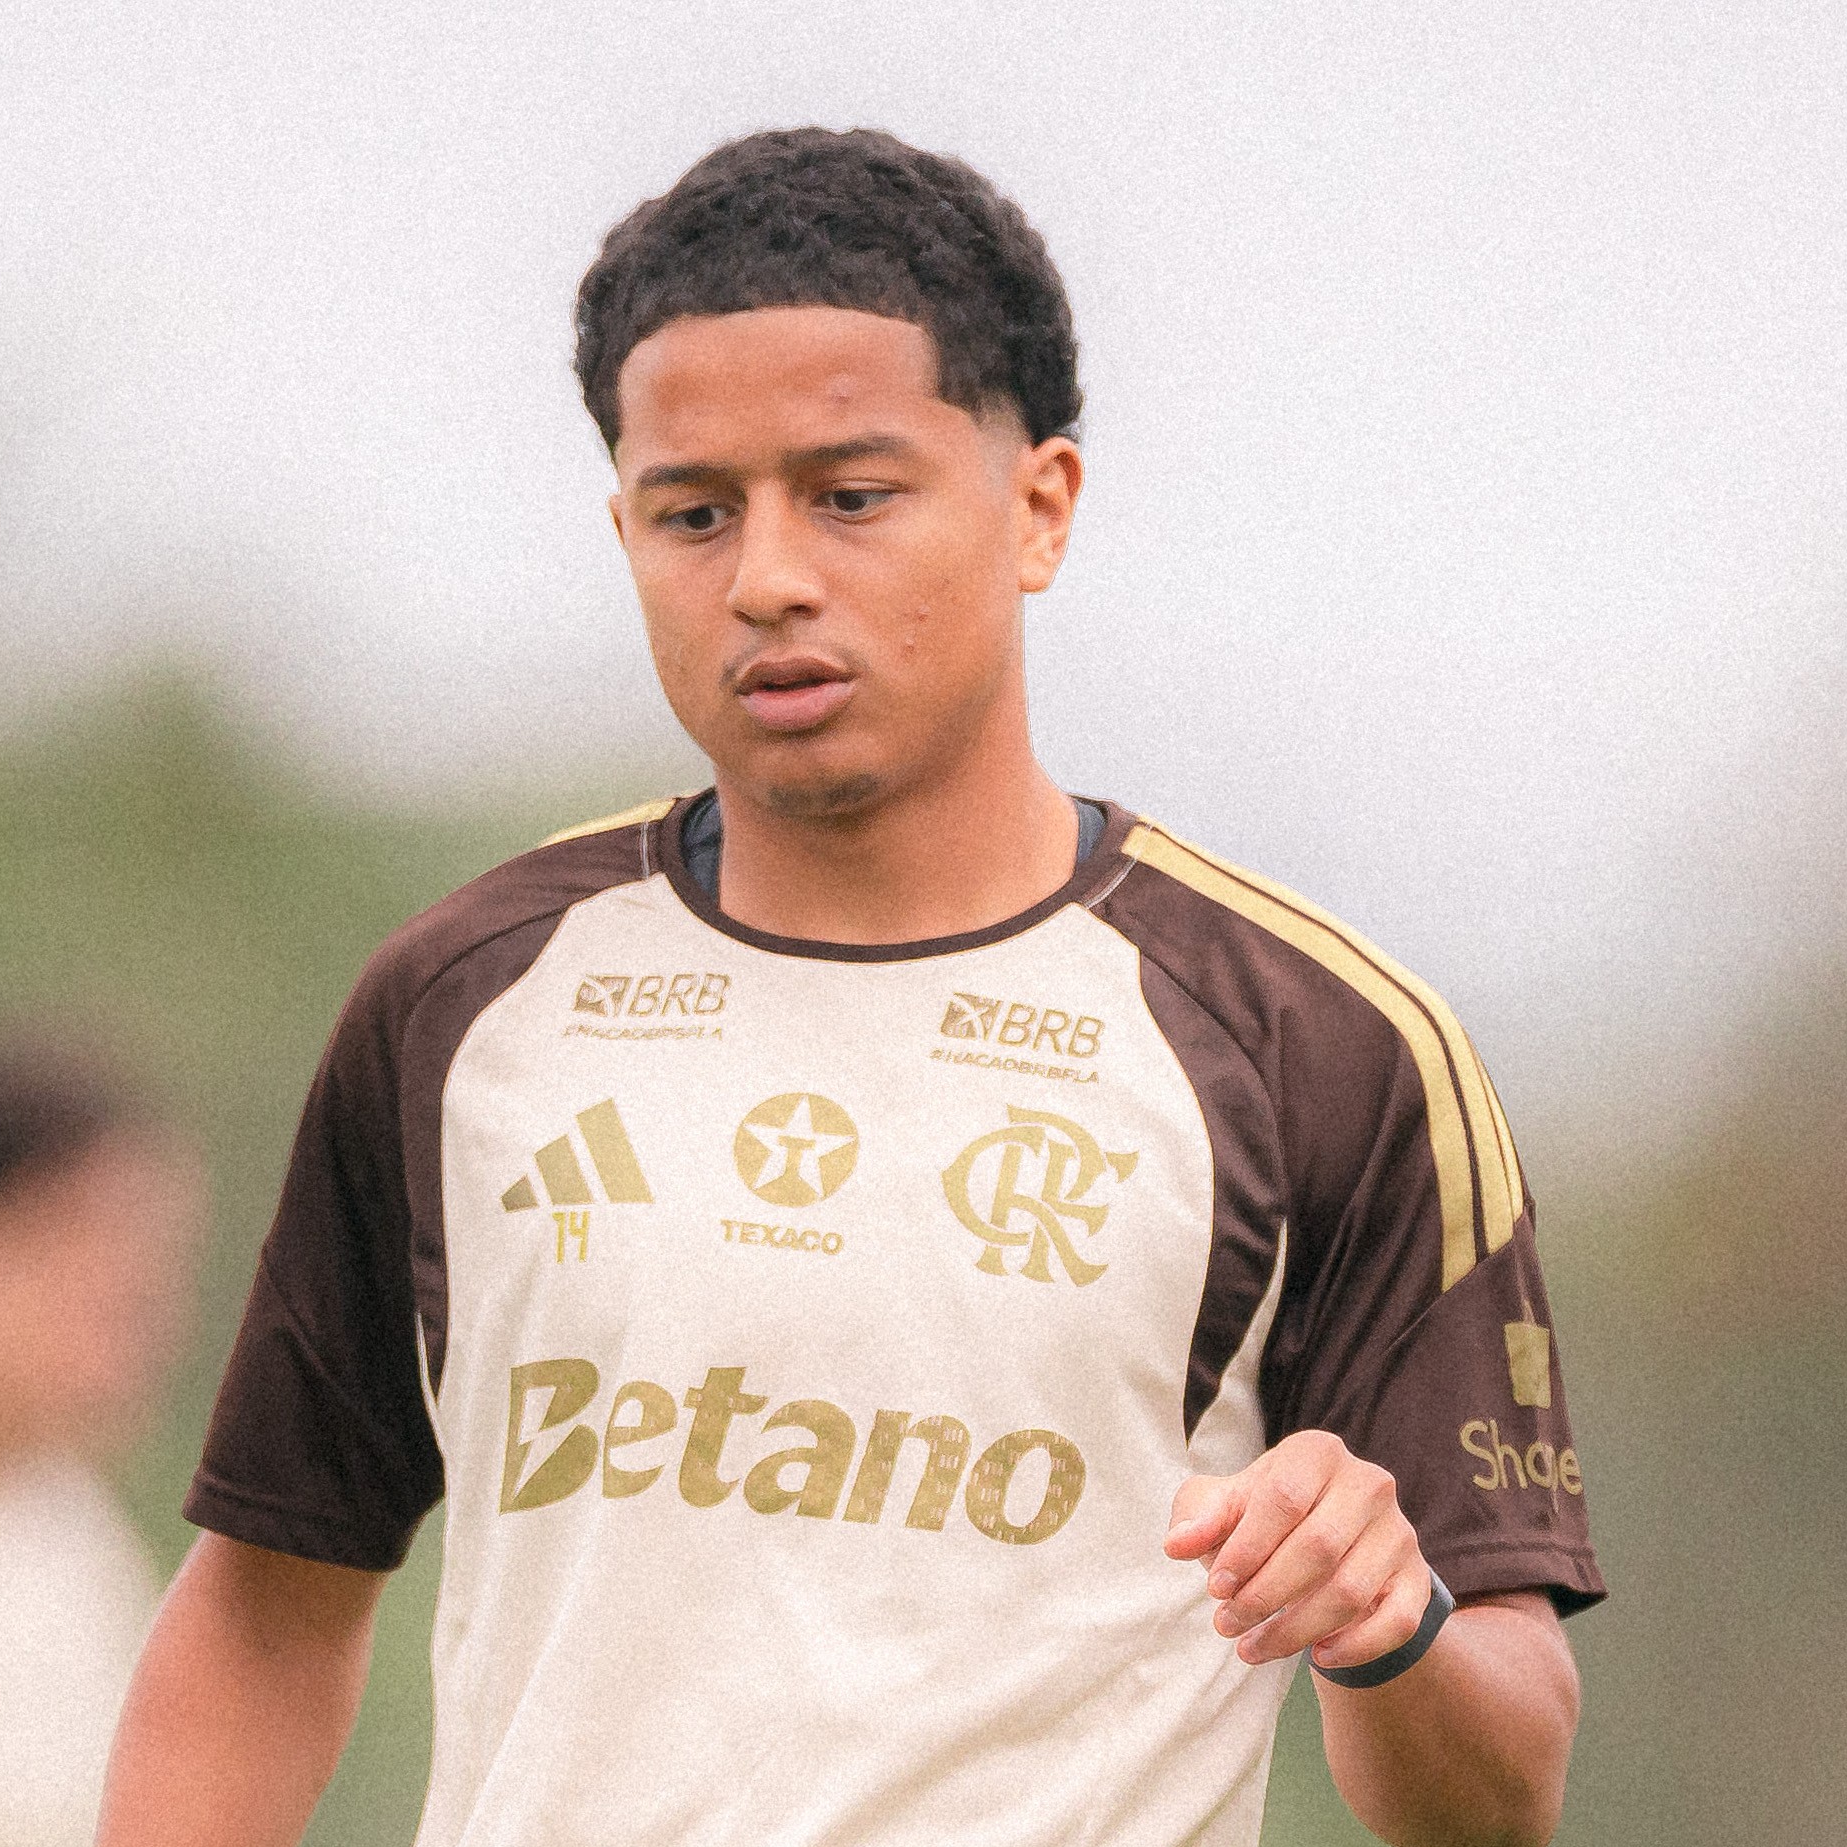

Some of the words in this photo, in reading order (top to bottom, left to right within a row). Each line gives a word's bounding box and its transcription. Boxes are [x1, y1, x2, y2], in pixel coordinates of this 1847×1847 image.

[627, 972, 730, 1017] BRB
[997, 1002, 1105, 1058] BRB
[552, 1210, 590, 1264] 14
[720, 1218, 845, 1256] TEXACO
[499, 1358, 1087, 1546] Betano
